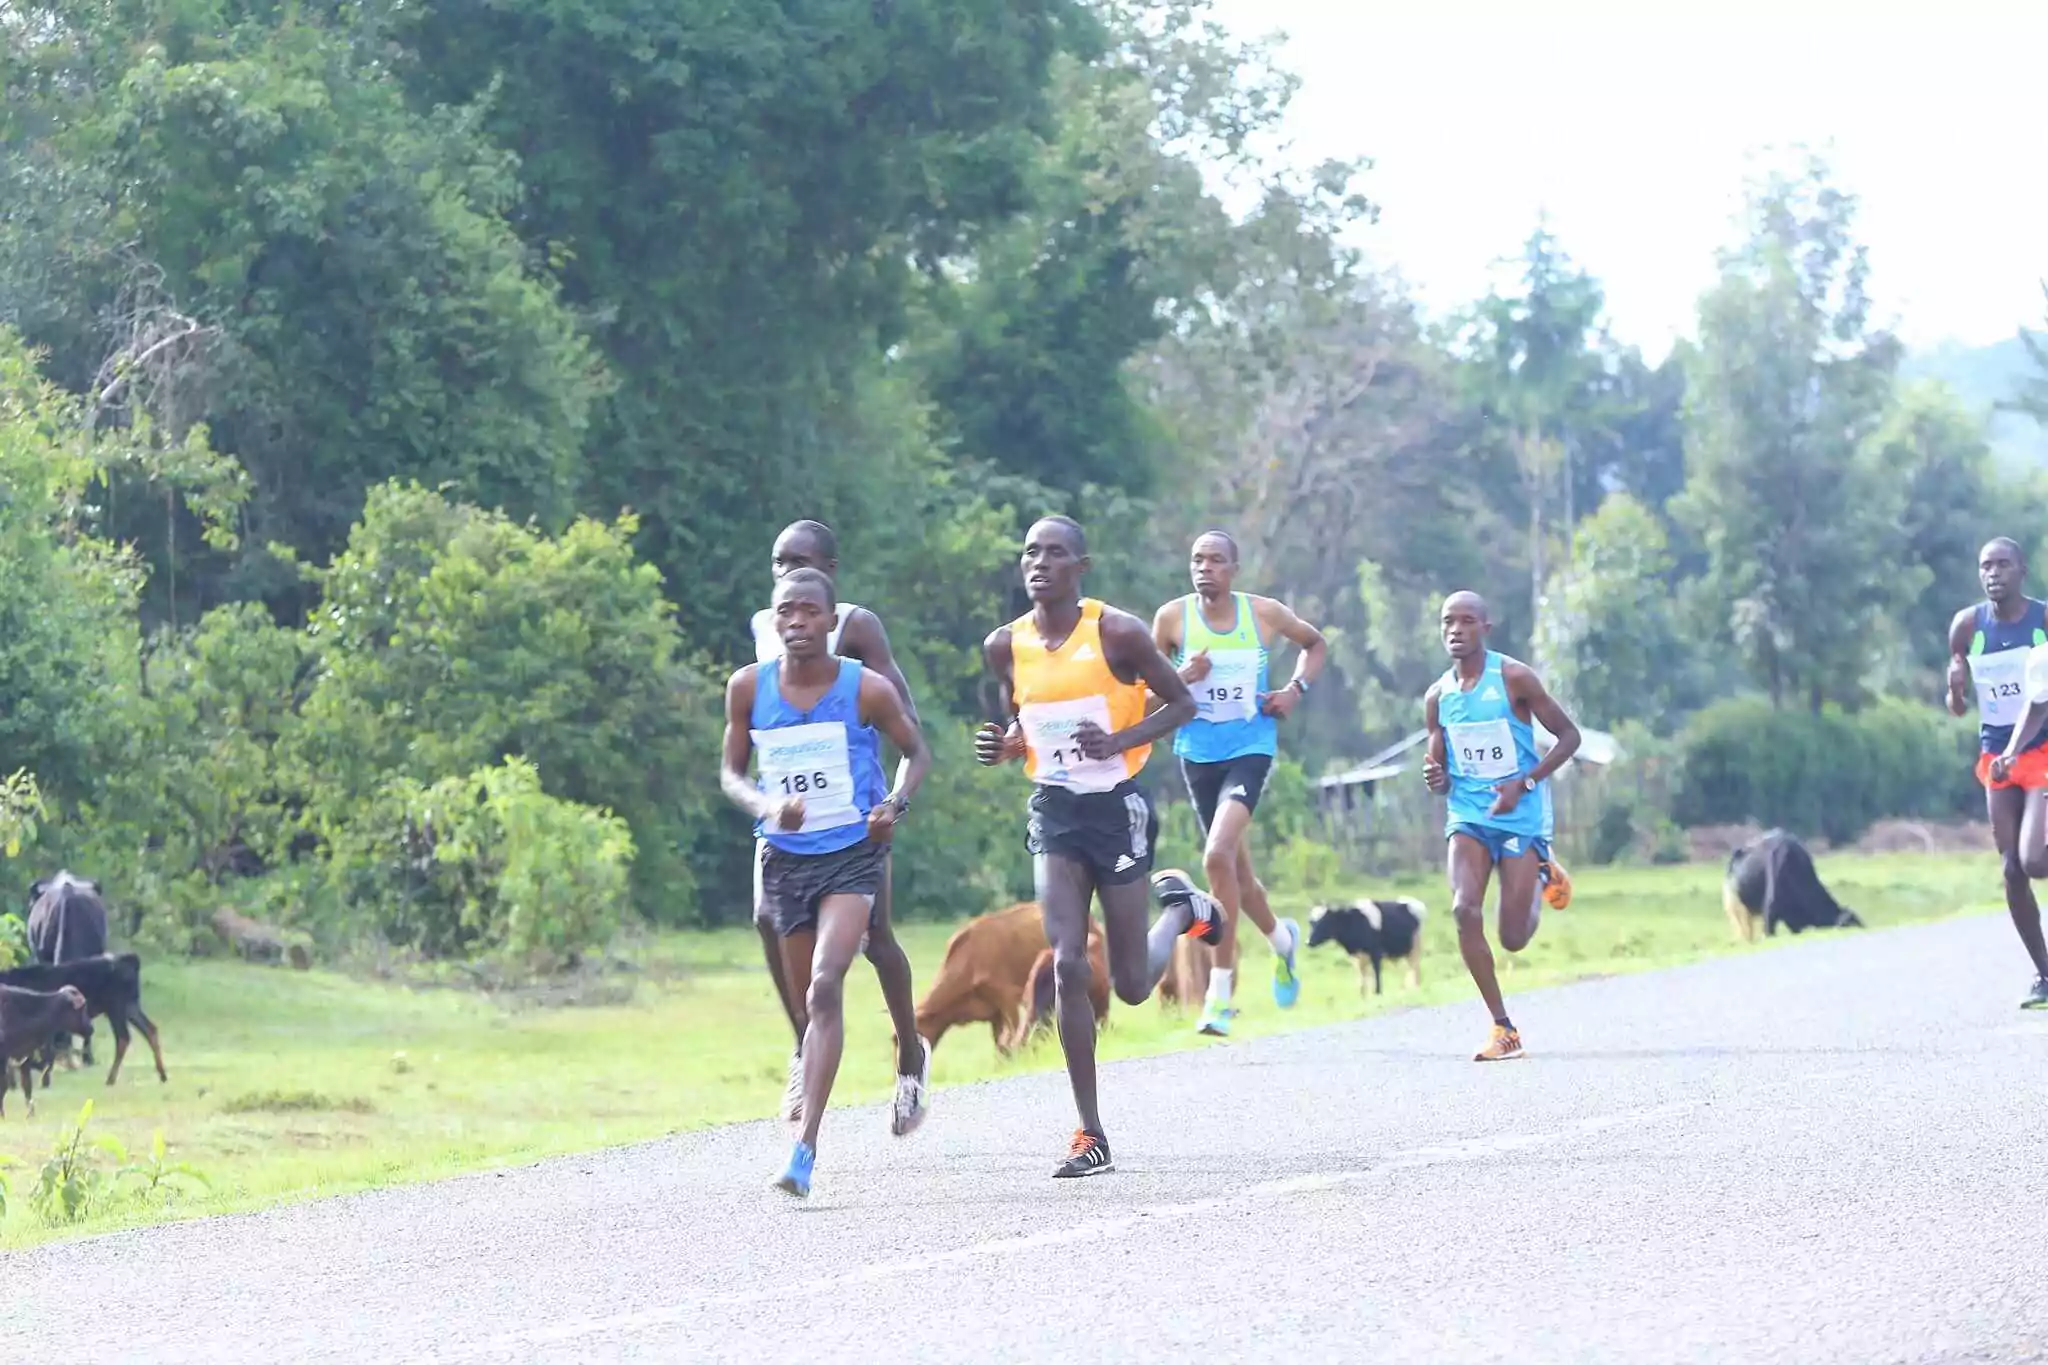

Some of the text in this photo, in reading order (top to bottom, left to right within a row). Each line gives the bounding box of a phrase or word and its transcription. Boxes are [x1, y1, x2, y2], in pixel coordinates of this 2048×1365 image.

[1206, 687, 1243, 701] 192
[1990, 682, 2021, 700] 123
[1053, 748, 1083, 765] 11
[1463, 746, 1504, 762] 078
[781, 772, 828, 794] 186
